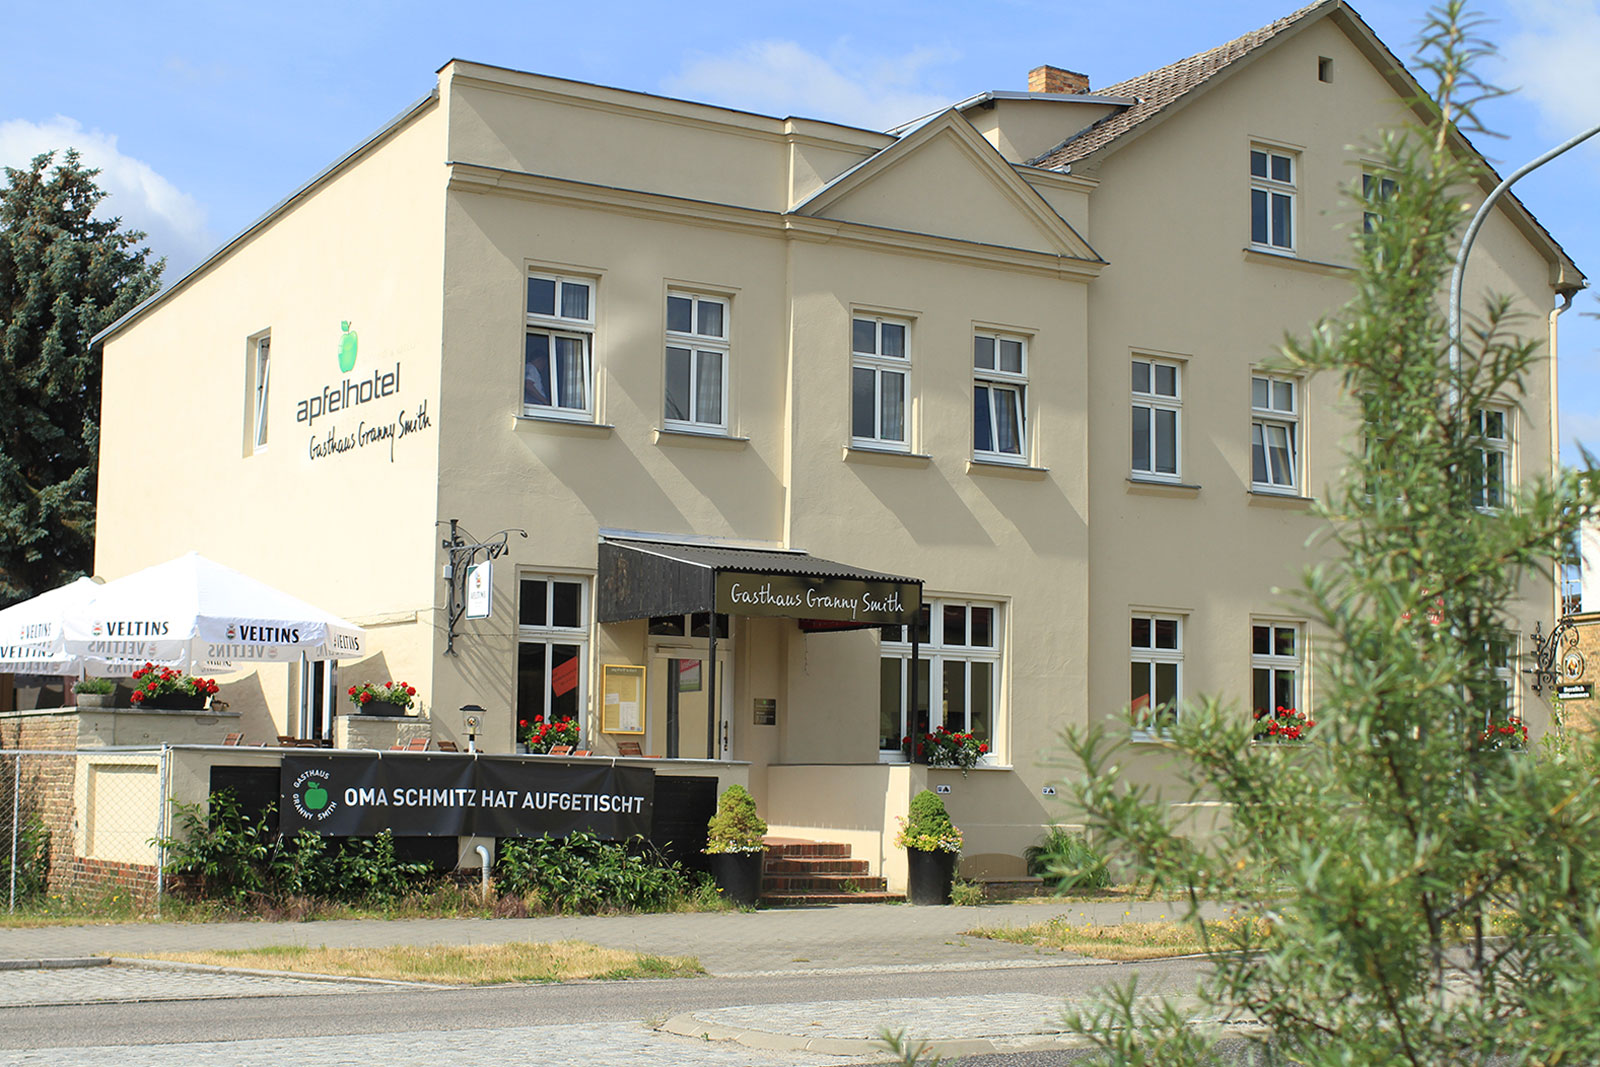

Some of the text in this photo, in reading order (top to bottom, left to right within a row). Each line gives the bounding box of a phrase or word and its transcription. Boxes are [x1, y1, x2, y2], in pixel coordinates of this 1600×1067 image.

[296, 362, 401, 426] apfelhotel
[309, 399, 432, 463] Gasthaus Granny Smith
[731, 583, 904, 620] Gasthaus Granny Smith
[107, 621, 169, 636] VELTINS
[240, 625, 300, 643] VELTINS
[336, 634, 360, 651] VELTINS
[292, 769, 331, 789] GASTHAUS
[292, 793, 338, 821] GRANNY SMITH
[344, 787, 645, 814] OMA SCHMITZ HAT AUFGETISCHT
